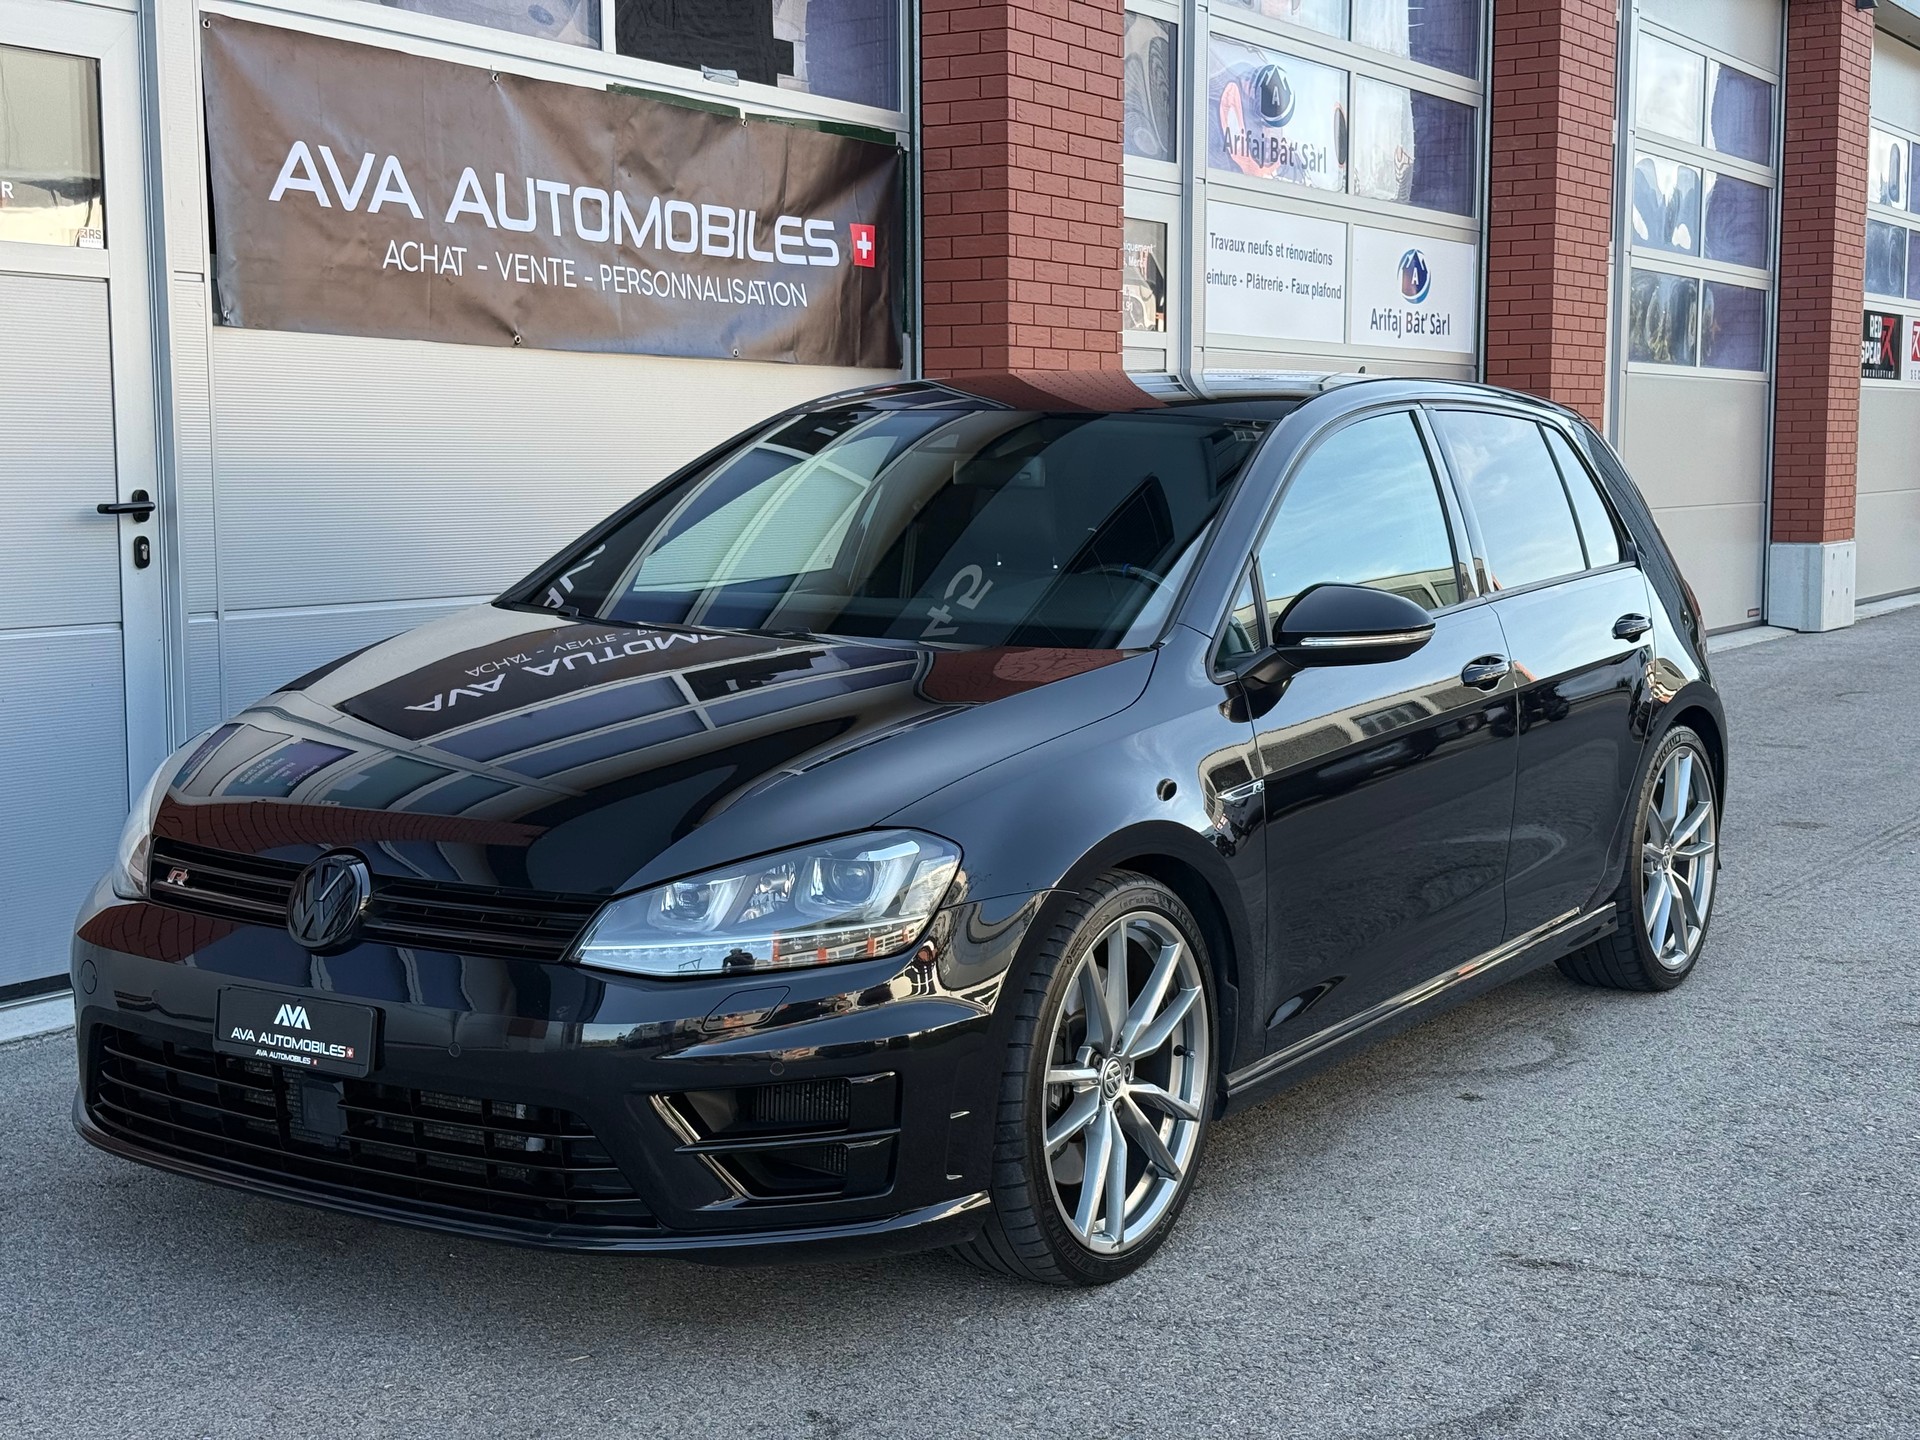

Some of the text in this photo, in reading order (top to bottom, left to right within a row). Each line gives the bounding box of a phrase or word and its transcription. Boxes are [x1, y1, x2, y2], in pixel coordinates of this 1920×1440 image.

[1223, 127, 1264, 168] Arifaj
[1302, 143, 1327, 174] Sàrl
[268, 140, 840, 267] AVA AUTOMOBILES
[1210, 232, 1333, 266] Travaux neufs et rénovations
[382, 240, 467, 276] ACHAT
[495, 251, 577, 288] VENTE
[599, 264, 808, 308] PERSONNALISATION
[1206, 268, 1237, 286] einture
[1246, 272, 1283, 292] Plâtrerie
[1291, 278, 1309, 295] Faux
[1312, 282, 1341, 300] plafond
[1411, 267, 1419, 285] A
[1370, 308, 1402, 339] Arifaj
[1430, 312, 1450, 336] Sàrl
[1869, 314, 1883, 338] RED
[1861, 341, 1881, 365] SPEAR
[273, 1003, 311, 1030] AVA
[231, 1026, 346, 1058] AVA AUTOMOBILES
[255, 1049, 311, 1065] AVA AUTOMOBILES
